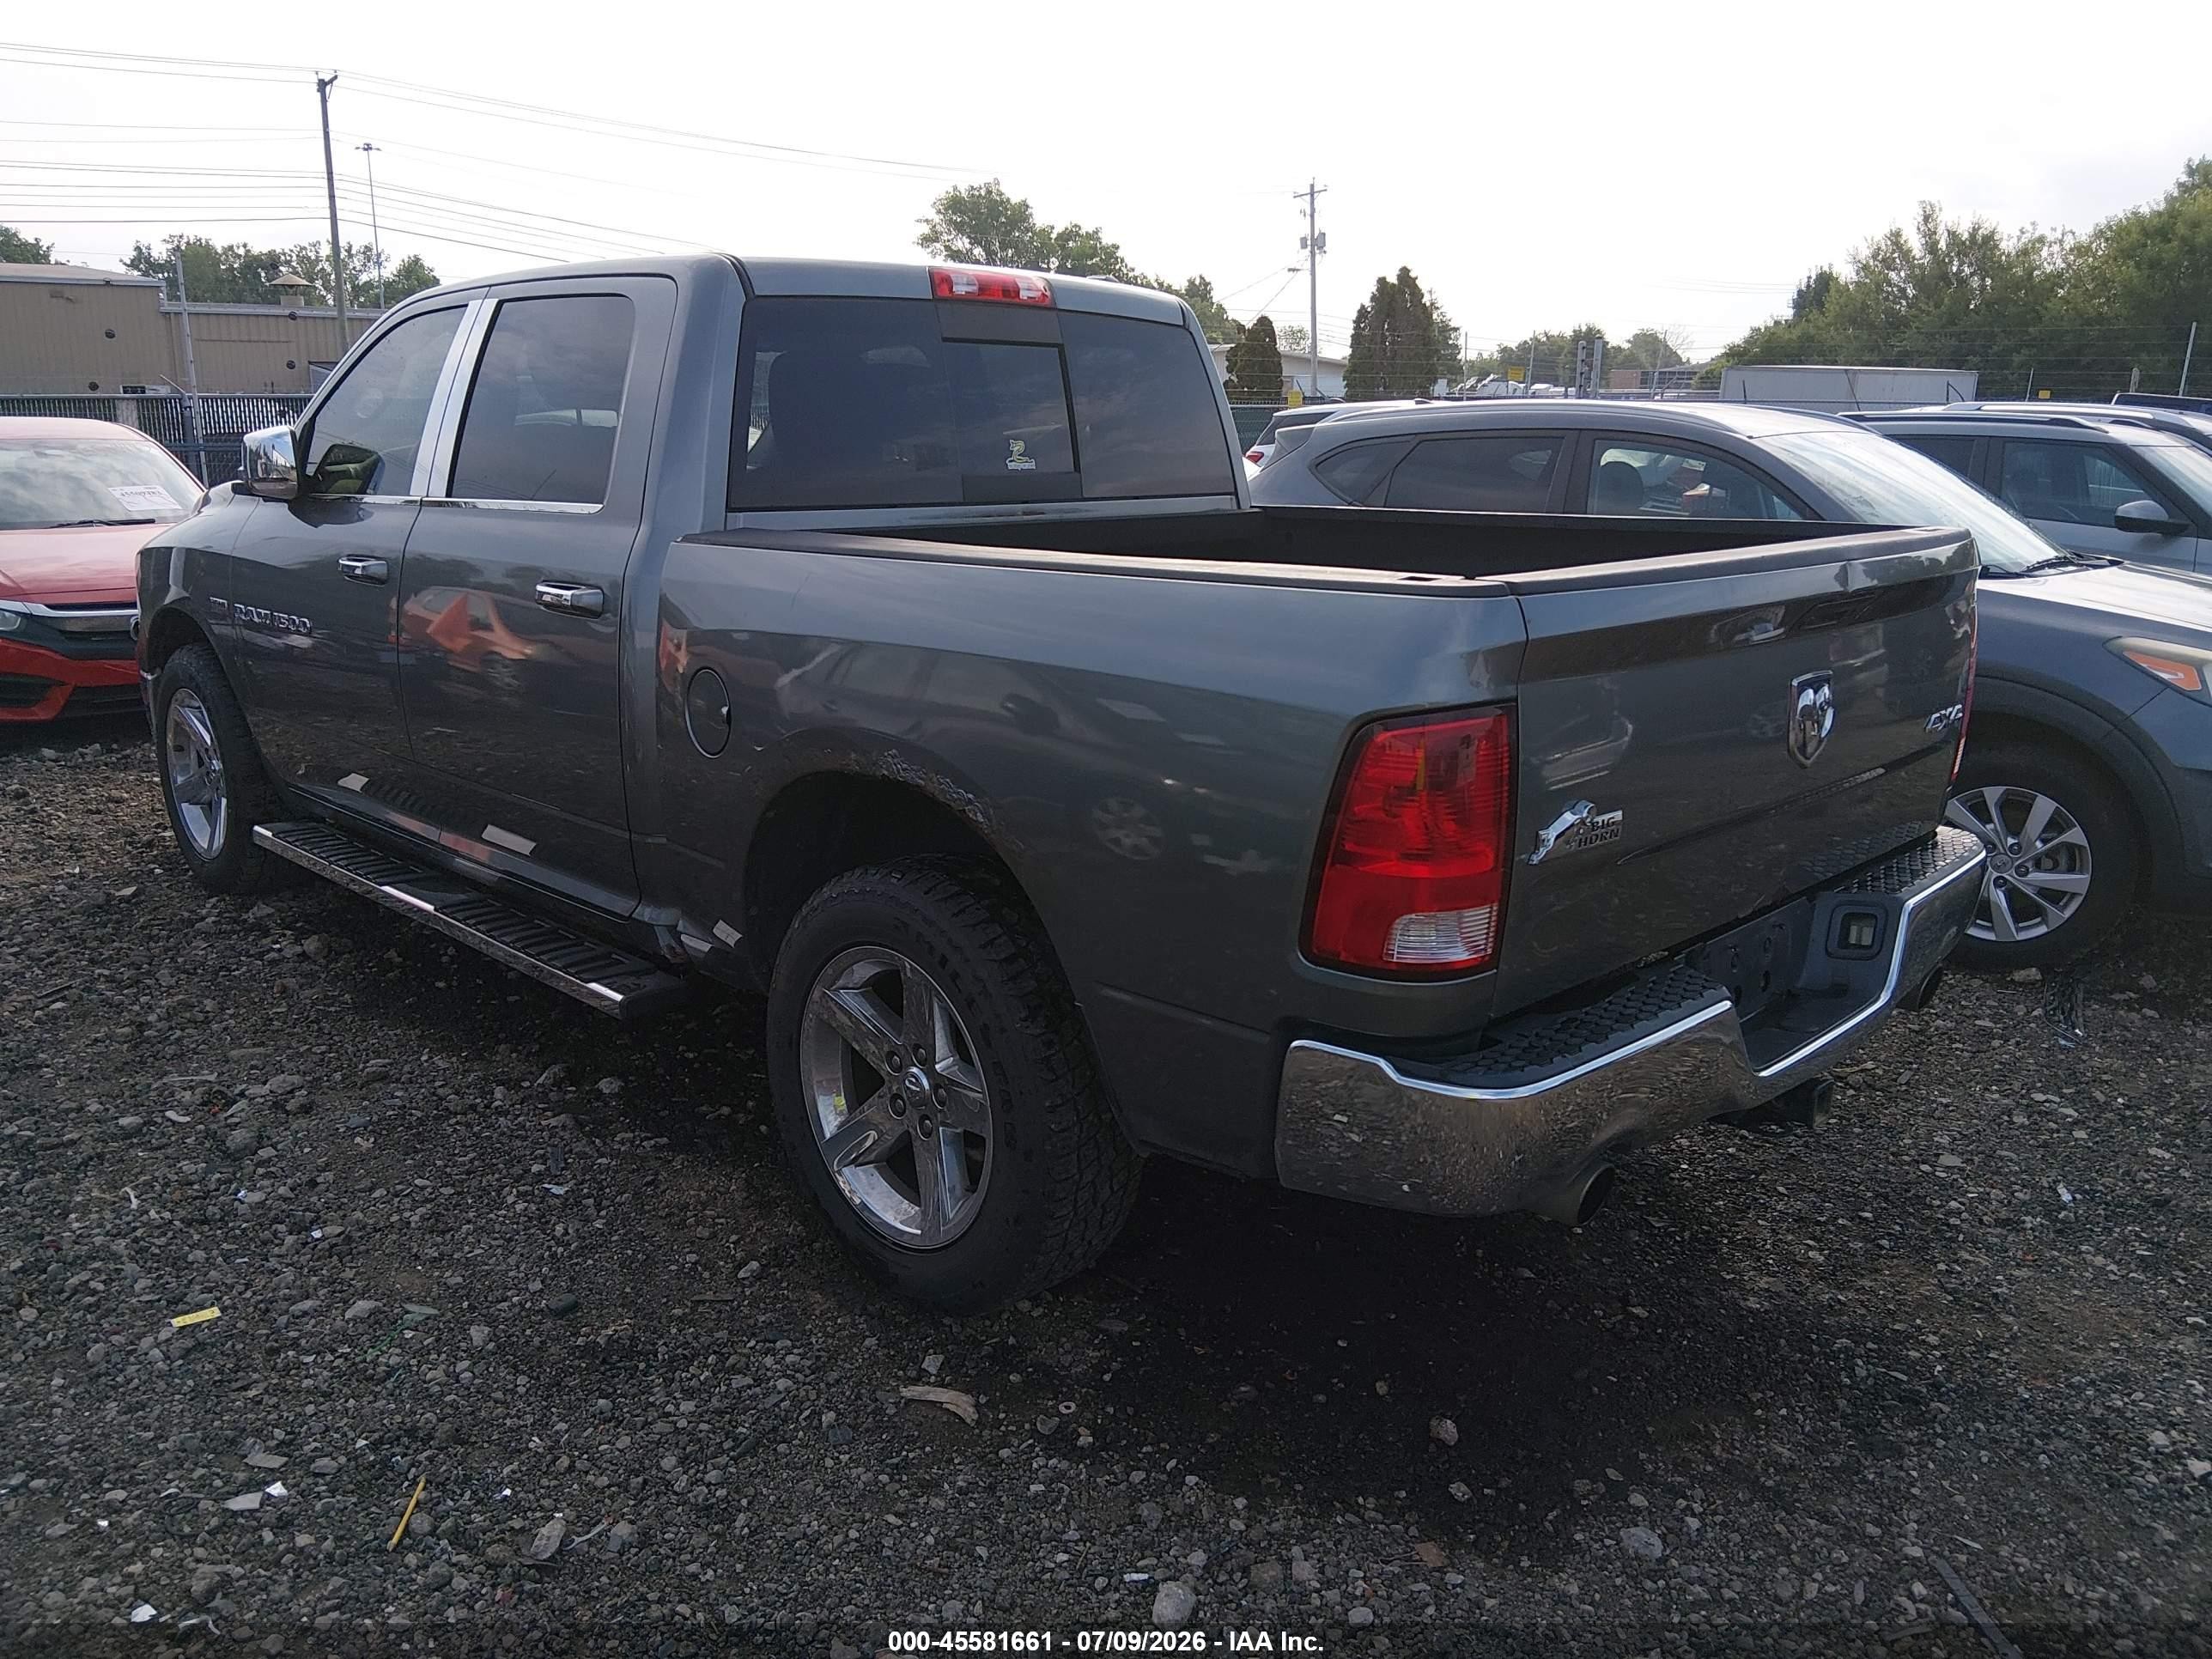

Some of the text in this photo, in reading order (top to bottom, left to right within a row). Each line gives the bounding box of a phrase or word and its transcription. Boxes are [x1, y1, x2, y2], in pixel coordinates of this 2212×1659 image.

[234, 603, 271, 625] RAM
[272, 612, 312, 634] 1500
[1590, 817, 1616, 831] BIG
[1578, 828, 1620, 848] HORN
